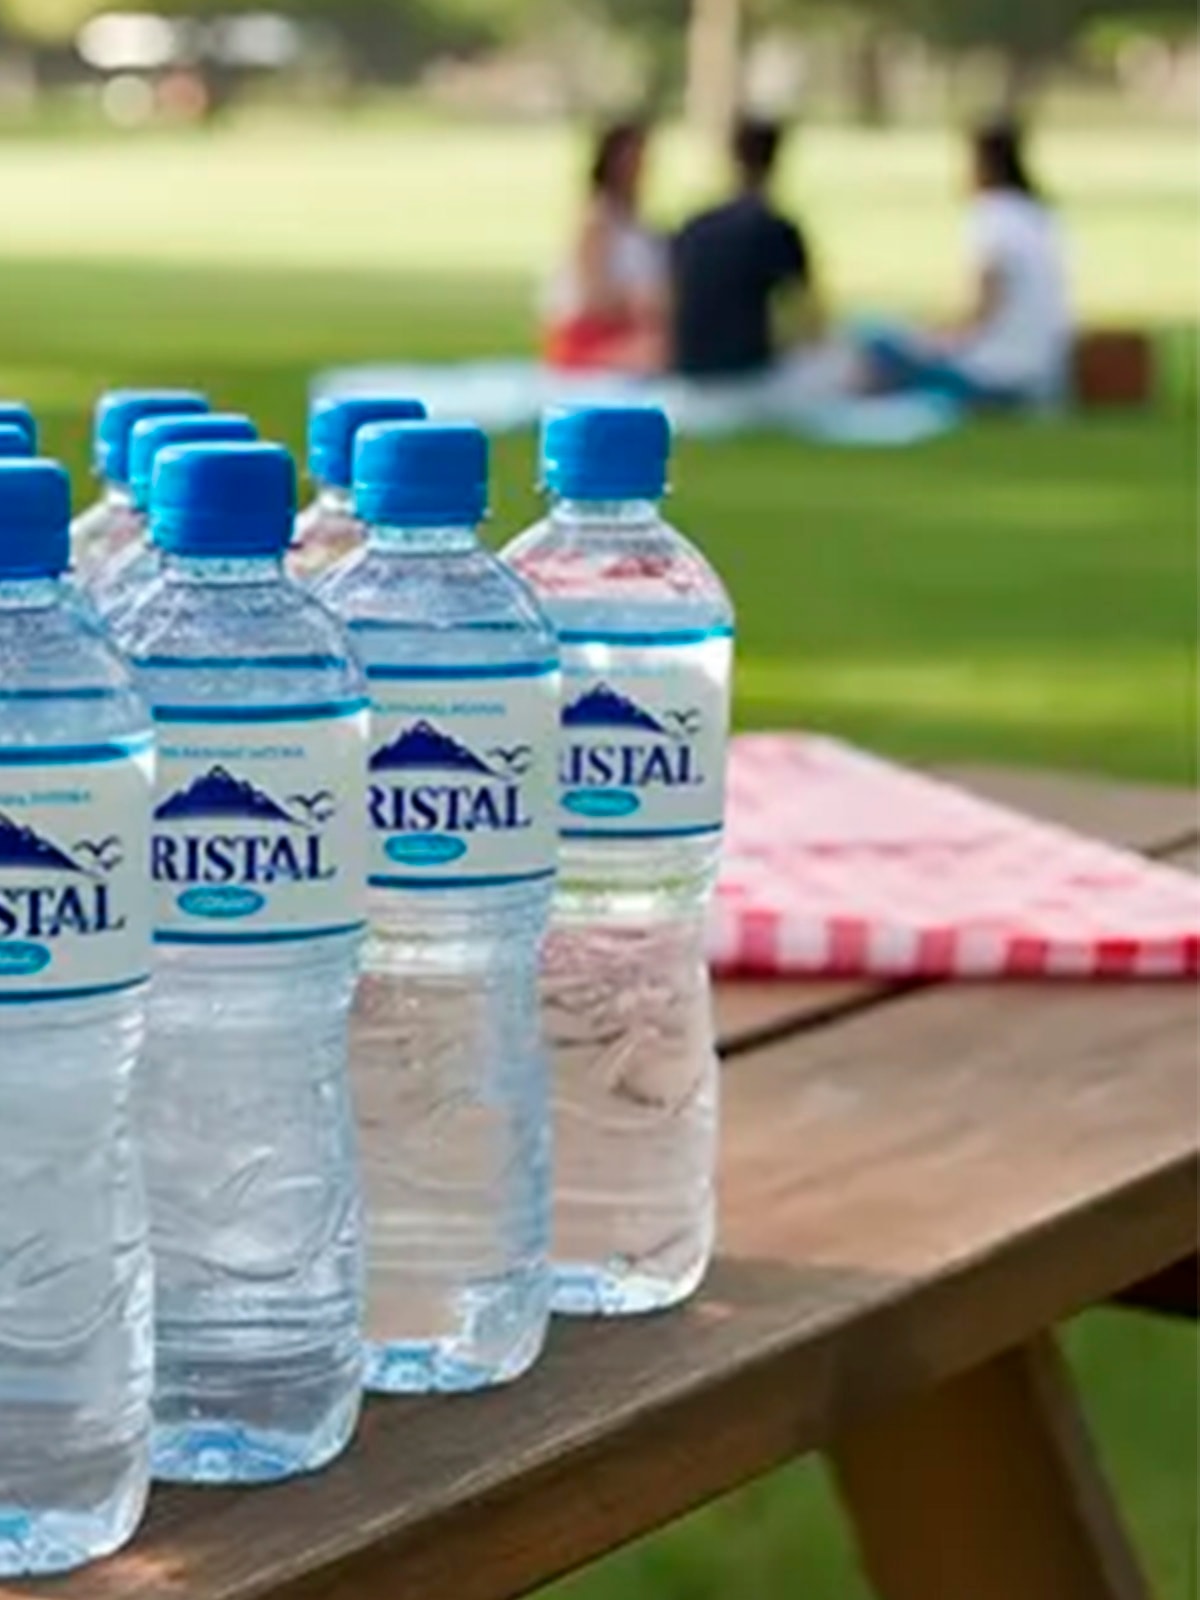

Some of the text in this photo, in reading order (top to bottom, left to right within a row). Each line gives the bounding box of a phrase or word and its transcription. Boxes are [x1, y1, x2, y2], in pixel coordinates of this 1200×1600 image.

[559, 745, 704, 787] ISTAL
[368, 785, 532, 831] RISTAL
[151, 834, 337, 883] RISTAL
